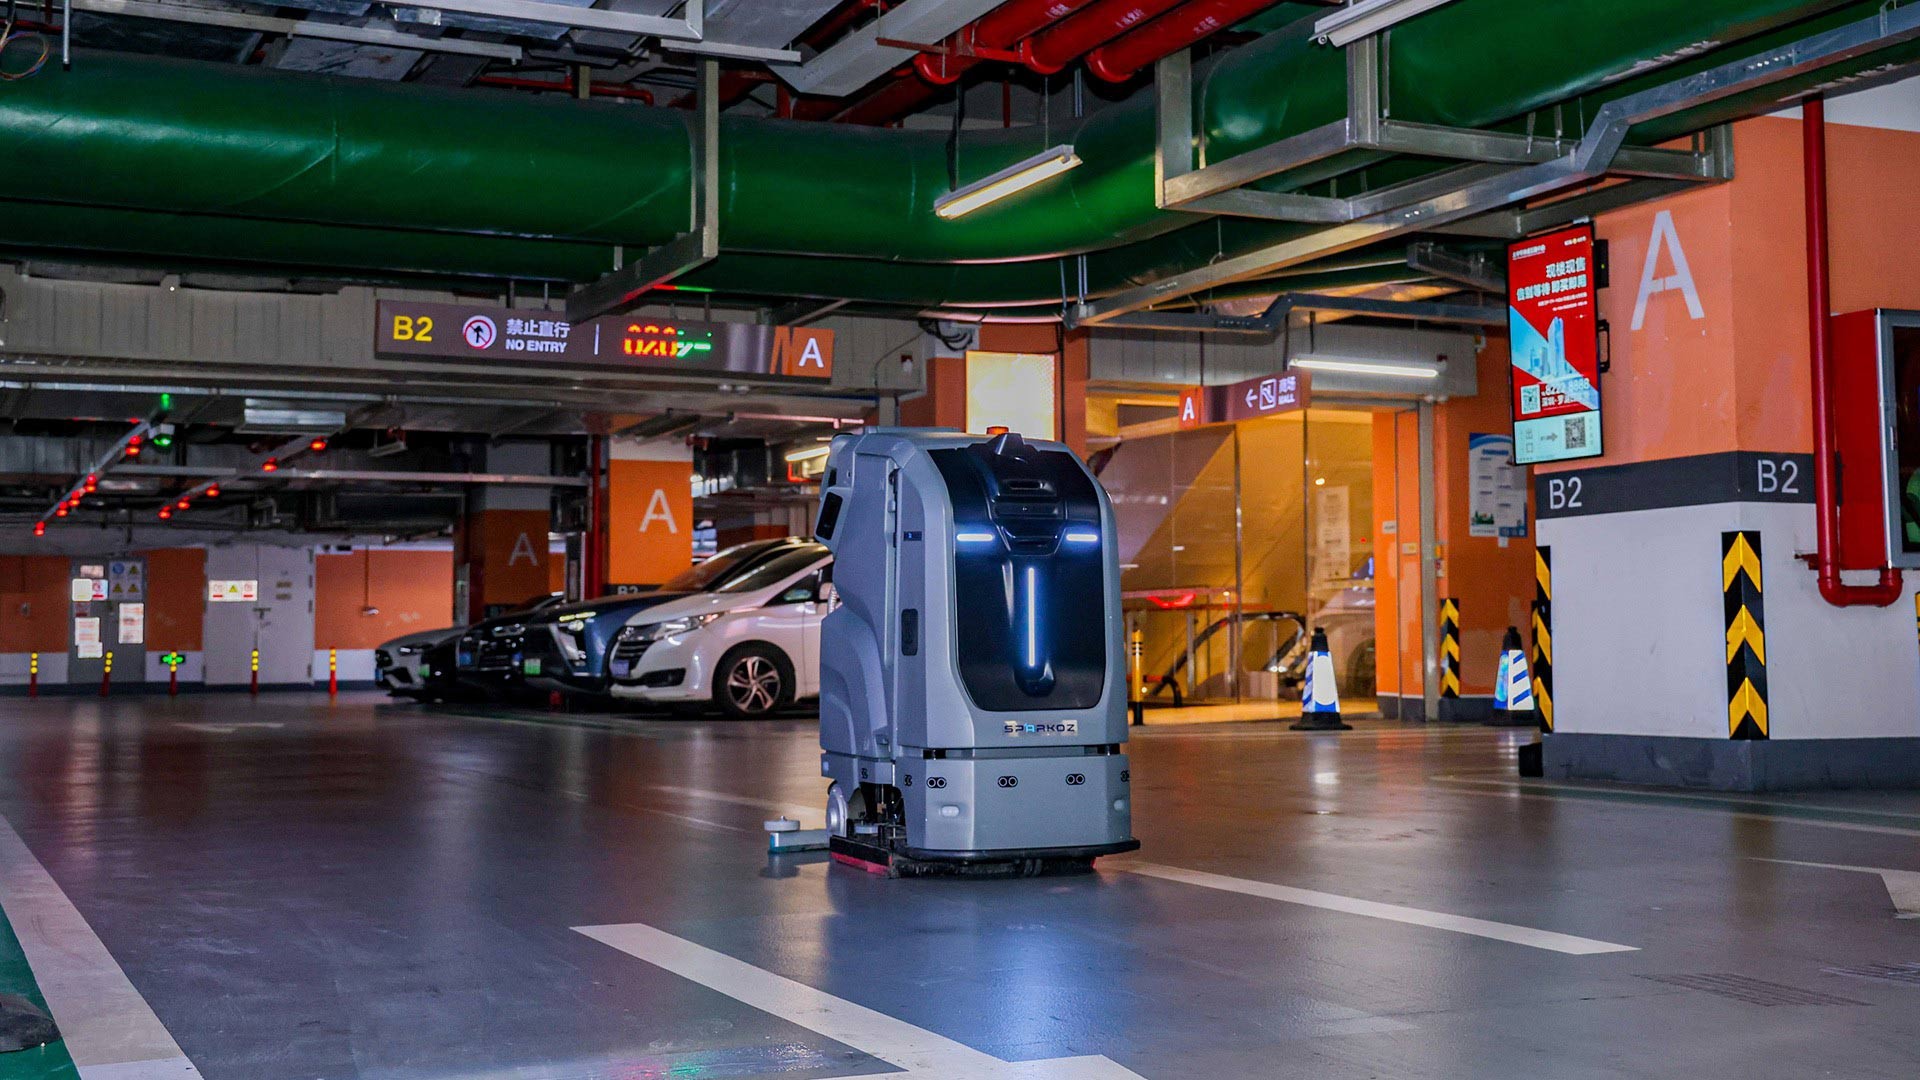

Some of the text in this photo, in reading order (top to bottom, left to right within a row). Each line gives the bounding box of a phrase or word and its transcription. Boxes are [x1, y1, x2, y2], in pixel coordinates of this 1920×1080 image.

[1630, 210, 1705, 331] A
[393, 315, 433, 342] B2
[506, 318, 570, 339] 禁止直行
[505, 339, 567, 353] NO ENTRY
[798, 337, 824, 368] A
[1182, 396, 1195, 421] A
[1757, 458, 1800, 494] B2
[1549, 476, 1583, 510] B2
[638, 488, 678, 534] A
[508, 532, 539, 567] A
[1004, 723, 1076, 733] SPARKOZ
